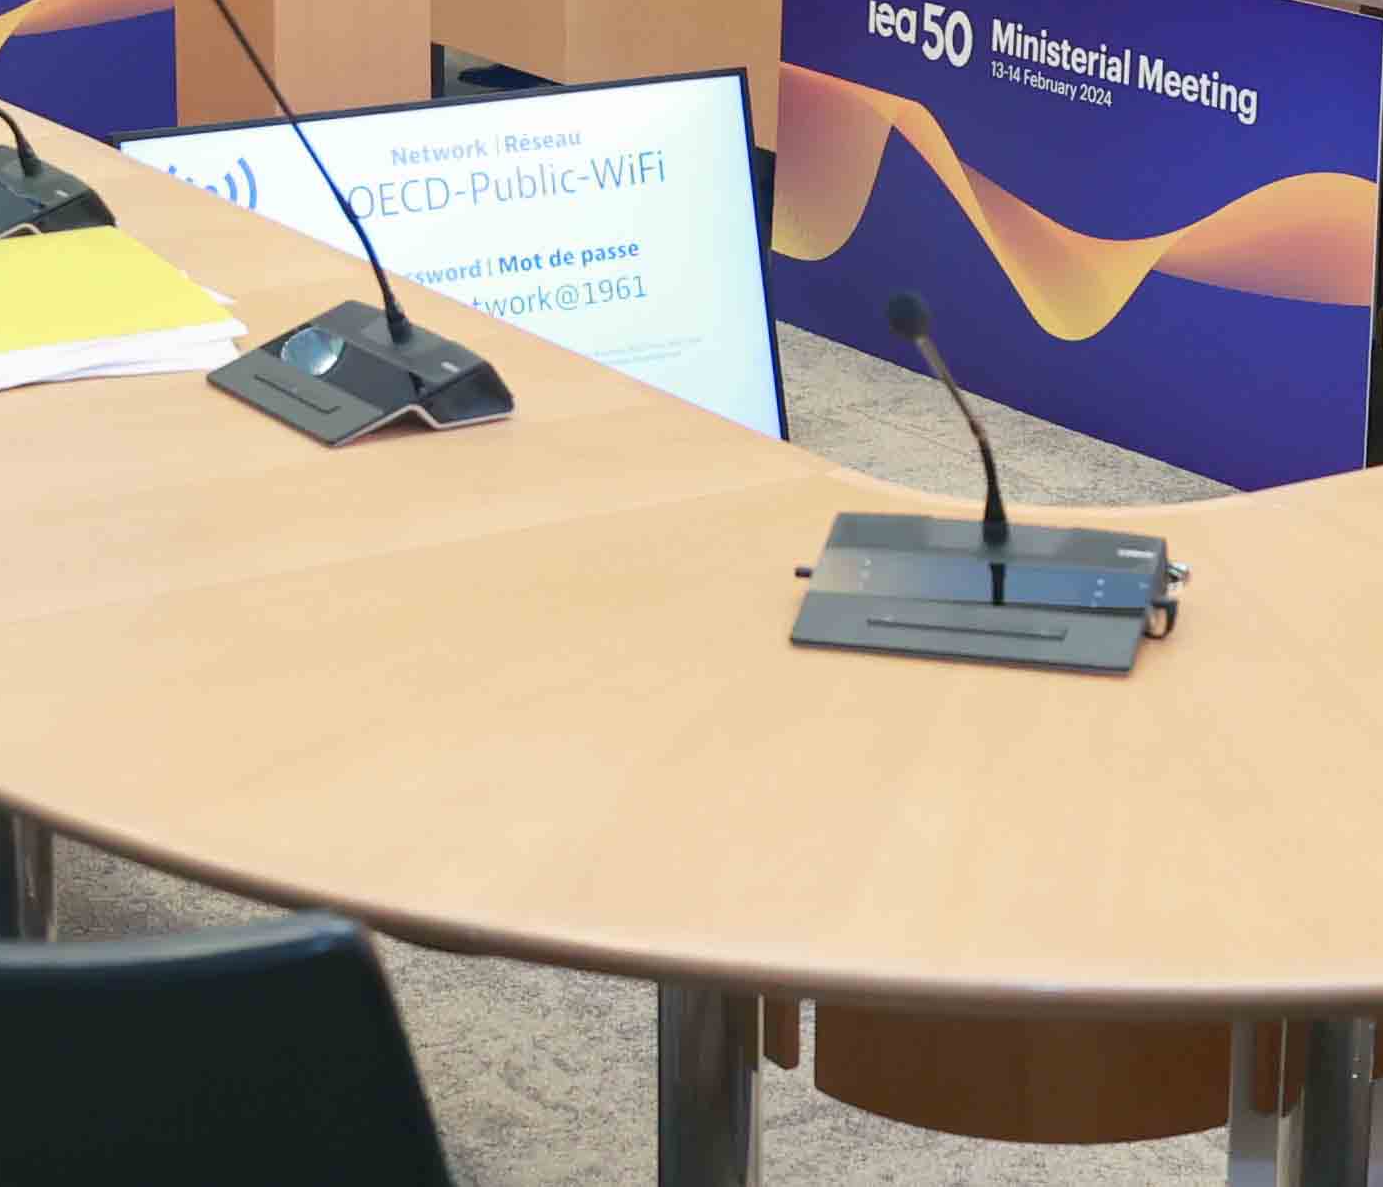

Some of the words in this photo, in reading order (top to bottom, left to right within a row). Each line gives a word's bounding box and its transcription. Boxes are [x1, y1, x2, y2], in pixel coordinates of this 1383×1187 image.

[921, 1, 974, 68] 50
[990, 60, 1022, 83] 13-14
[1023, 69, 1077, 102] February
[1079, 83, 1114, 108] 2024
[991, 18, 1131, 86] Ministerial
[1137, 53, 1259, 126] Meeting
[390, 138, 488, 166] Network
[504, 130, 582, 153] Réseau
[347, 149, 666, 220] OECD-Public-WiFi
[498, 252, 543, 275] Mot
[548, 247, 575, 267] de
[580, 240, 641, 267] passe
